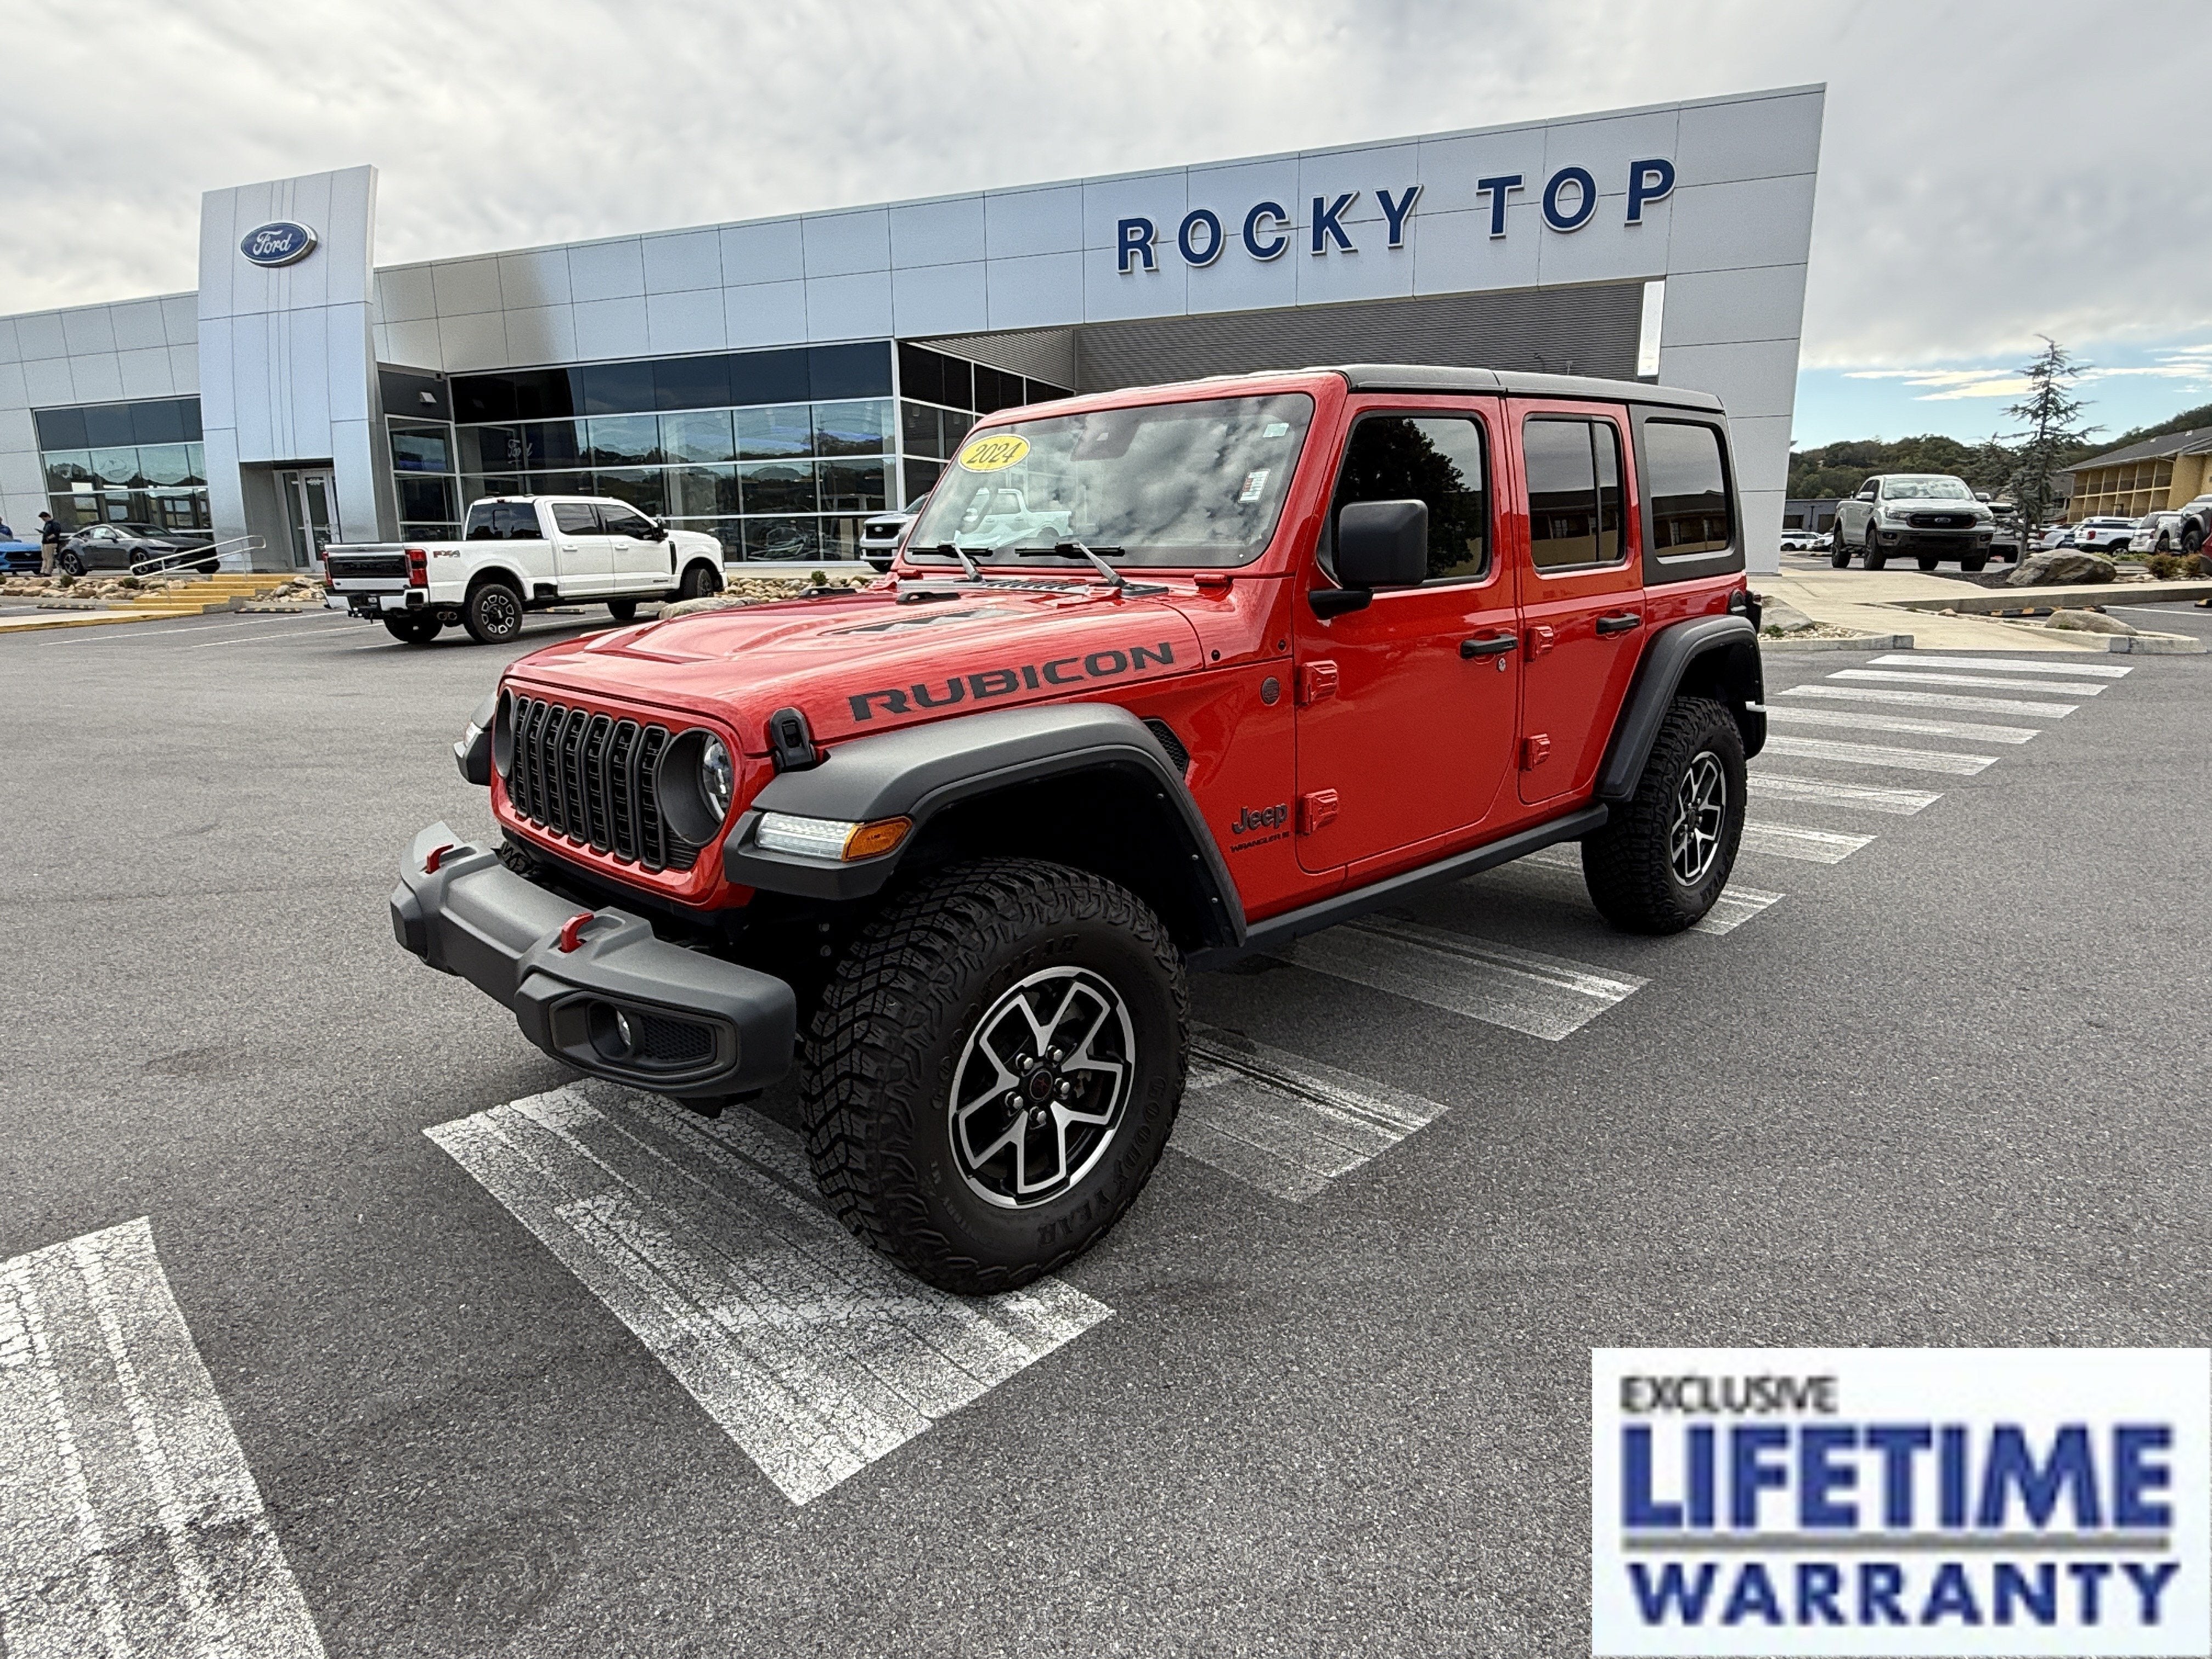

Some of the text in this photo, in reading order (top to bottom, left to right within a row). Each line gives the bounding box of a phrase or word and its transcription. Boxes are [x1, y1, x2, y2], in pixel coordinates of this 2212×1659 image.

[1117, 157, 1677, 273] ROCKY TOP
[252, 229, 293, 256] Ford
[966, 442, 1022, 464] 2024
[848, 642, 1174, 721] RUBICON
[1232, 803, 1288, 834] Jeep
[1229, 833, 1281, 853] WRANGLER
